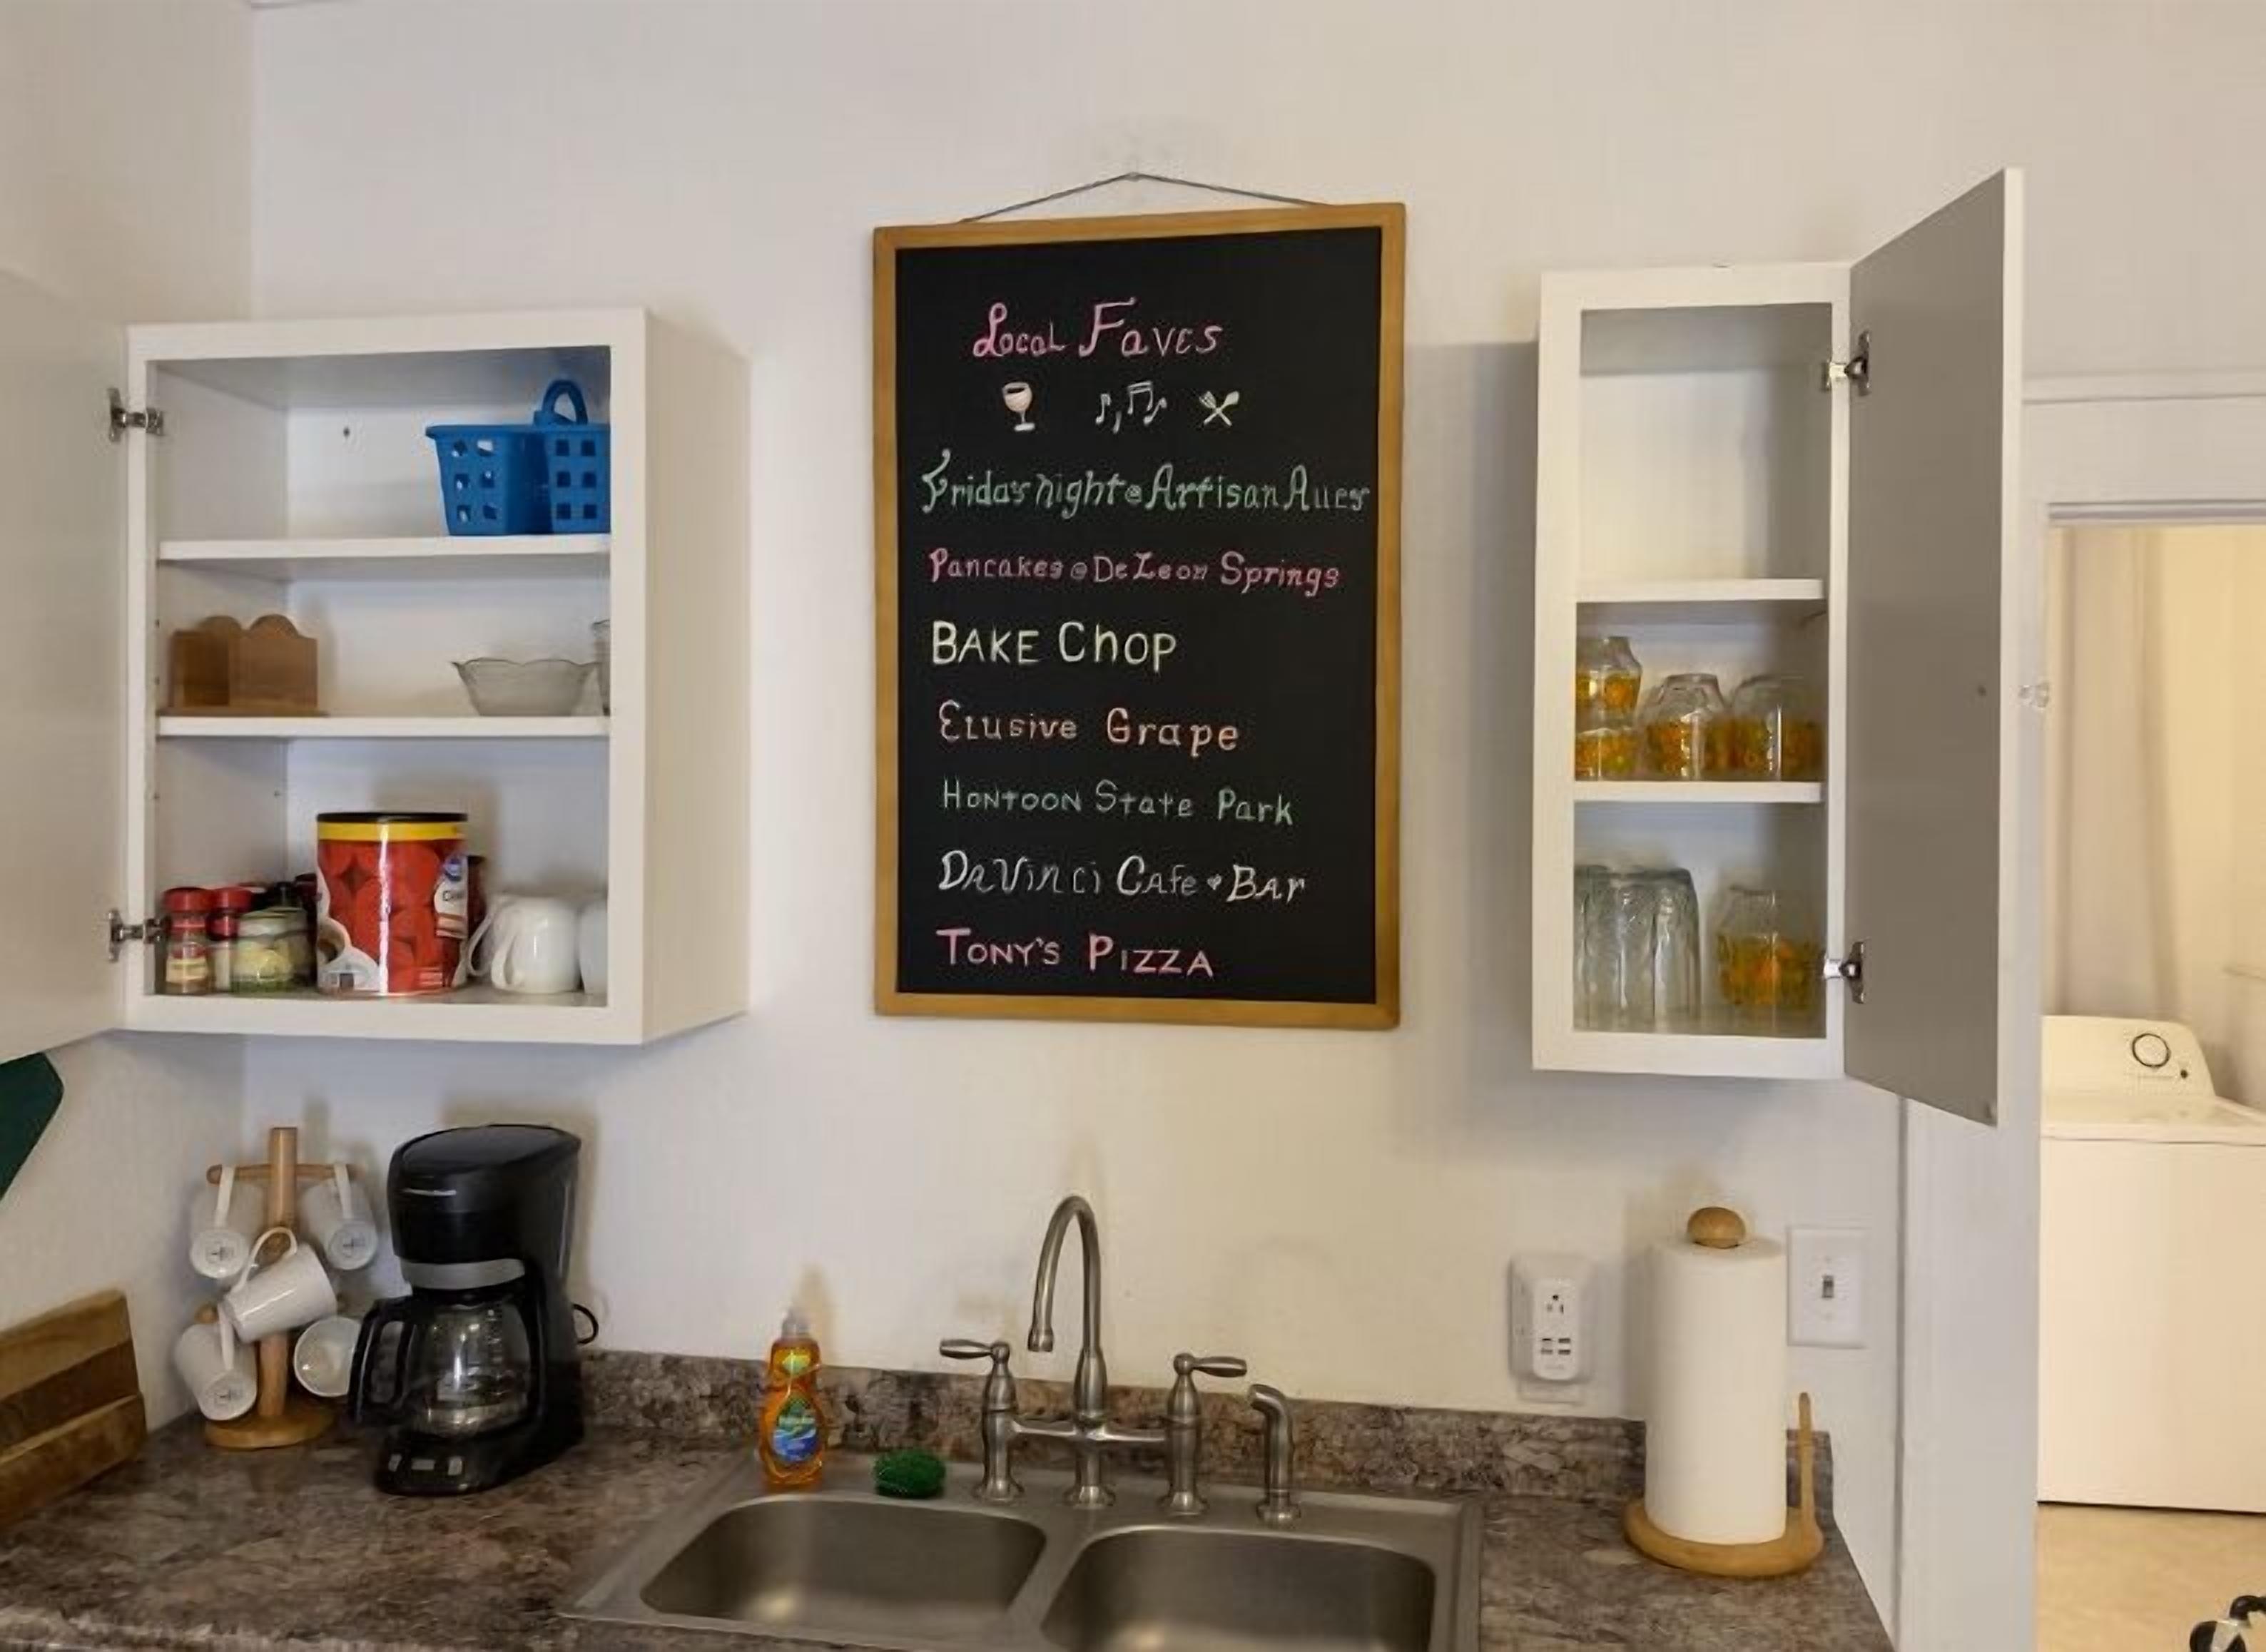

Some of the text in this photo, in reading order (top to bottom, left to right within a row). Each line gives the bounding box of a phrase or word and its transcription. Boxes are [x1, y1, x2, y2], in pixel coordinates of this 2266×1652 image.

[1079, 297, 1222, 357] Faves
[1145, 464, 1278, 510] Artisan
[929, 548, 1063, 582] Pancakes
[1221, 551, 1339, 597] Springs
[933, 621, 1039, 664] BAKE
[1107, 708, 1238, 758] Grape
[1096, 780, 1192, 816] State
[1219, 789, 1292, 825] Park
[936, 928, 1213, 977] TONY'S PIZZA
